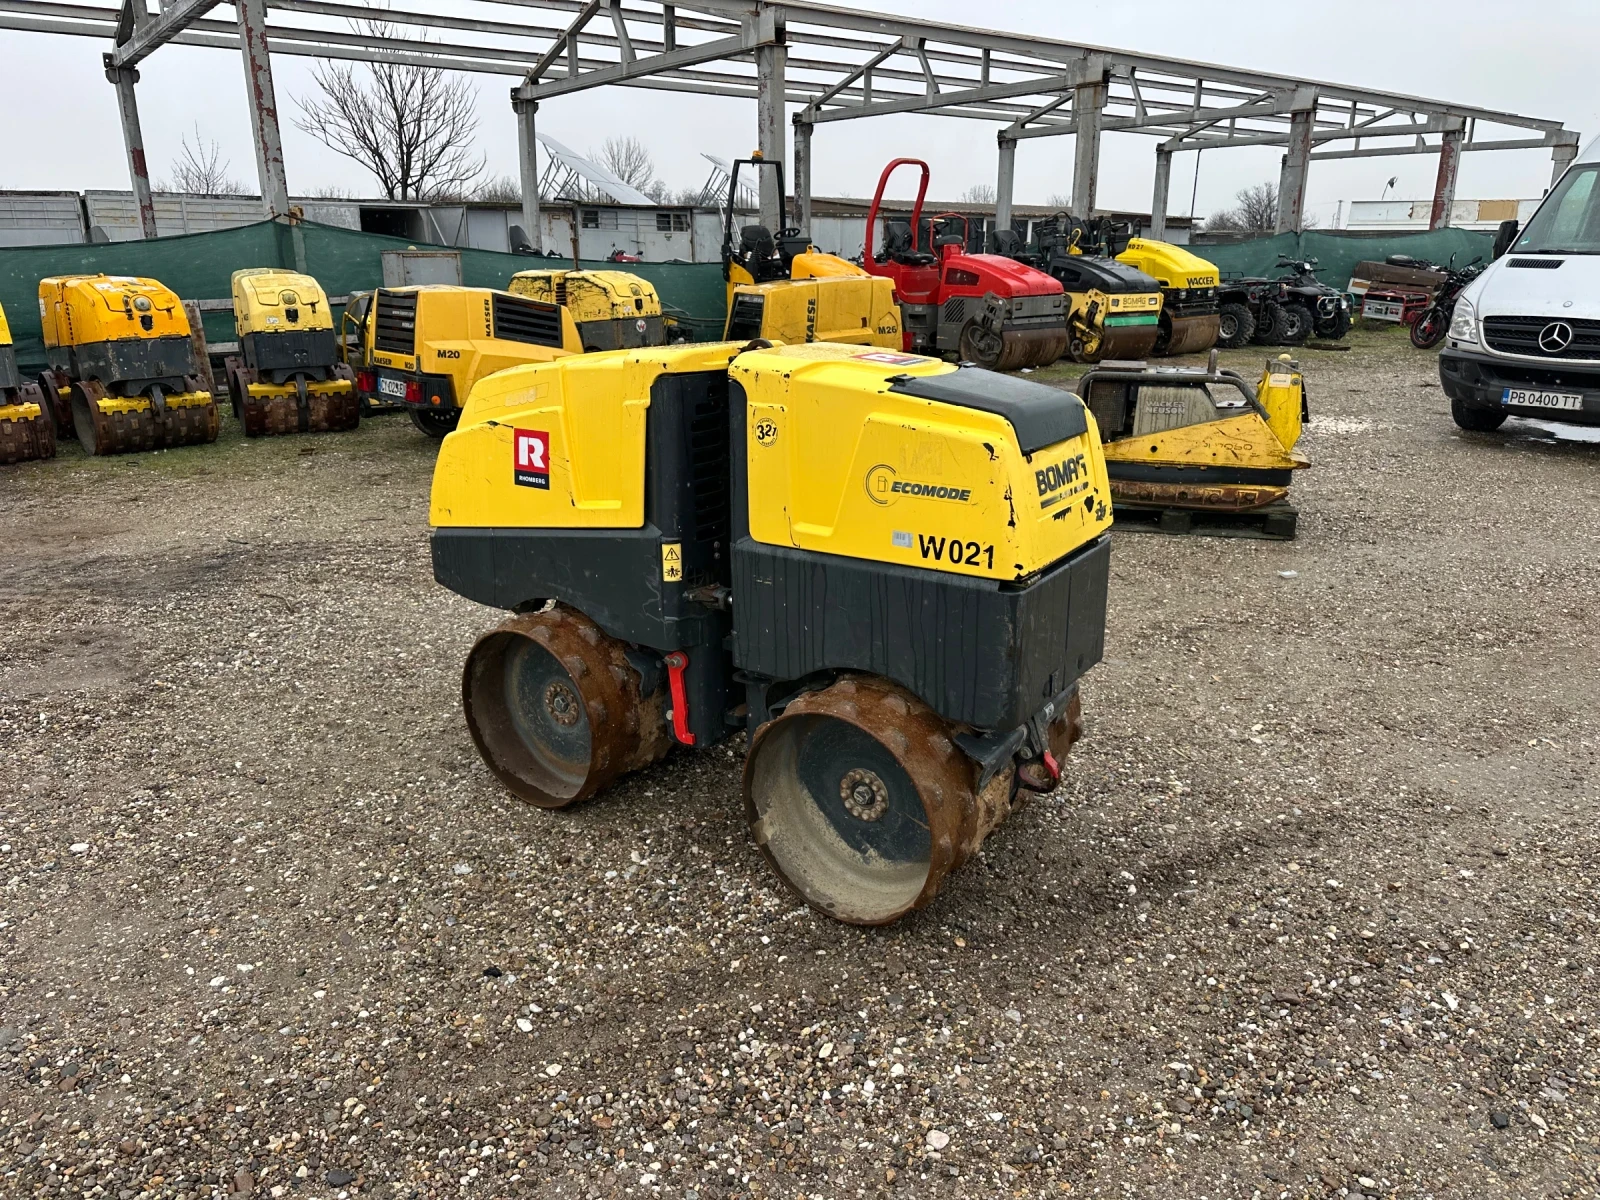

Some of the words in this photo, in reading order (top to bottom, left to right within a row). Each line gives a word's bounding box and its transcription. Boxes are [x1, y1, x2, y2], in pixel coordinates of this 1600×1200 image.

[1187, 276, 1215, 286] WACKER
[1123, 297, 1146, 305] BOMAG
[878, 326, 897, 334] M26
[437, 350, 460, 359] M20
[374, 356, 392, 365] KAESER
[1510, 391, 1526, 404] PB
[1528, 393, 1559, 406] 0400
[1562, 395, 1579, 408] TT
[518, 436, 545, 468] R
[518, 475, 545, 485] RHOMBERG
[891, 481, 971, 502] ECOMODE
[918, 534, 994, 570] W021
